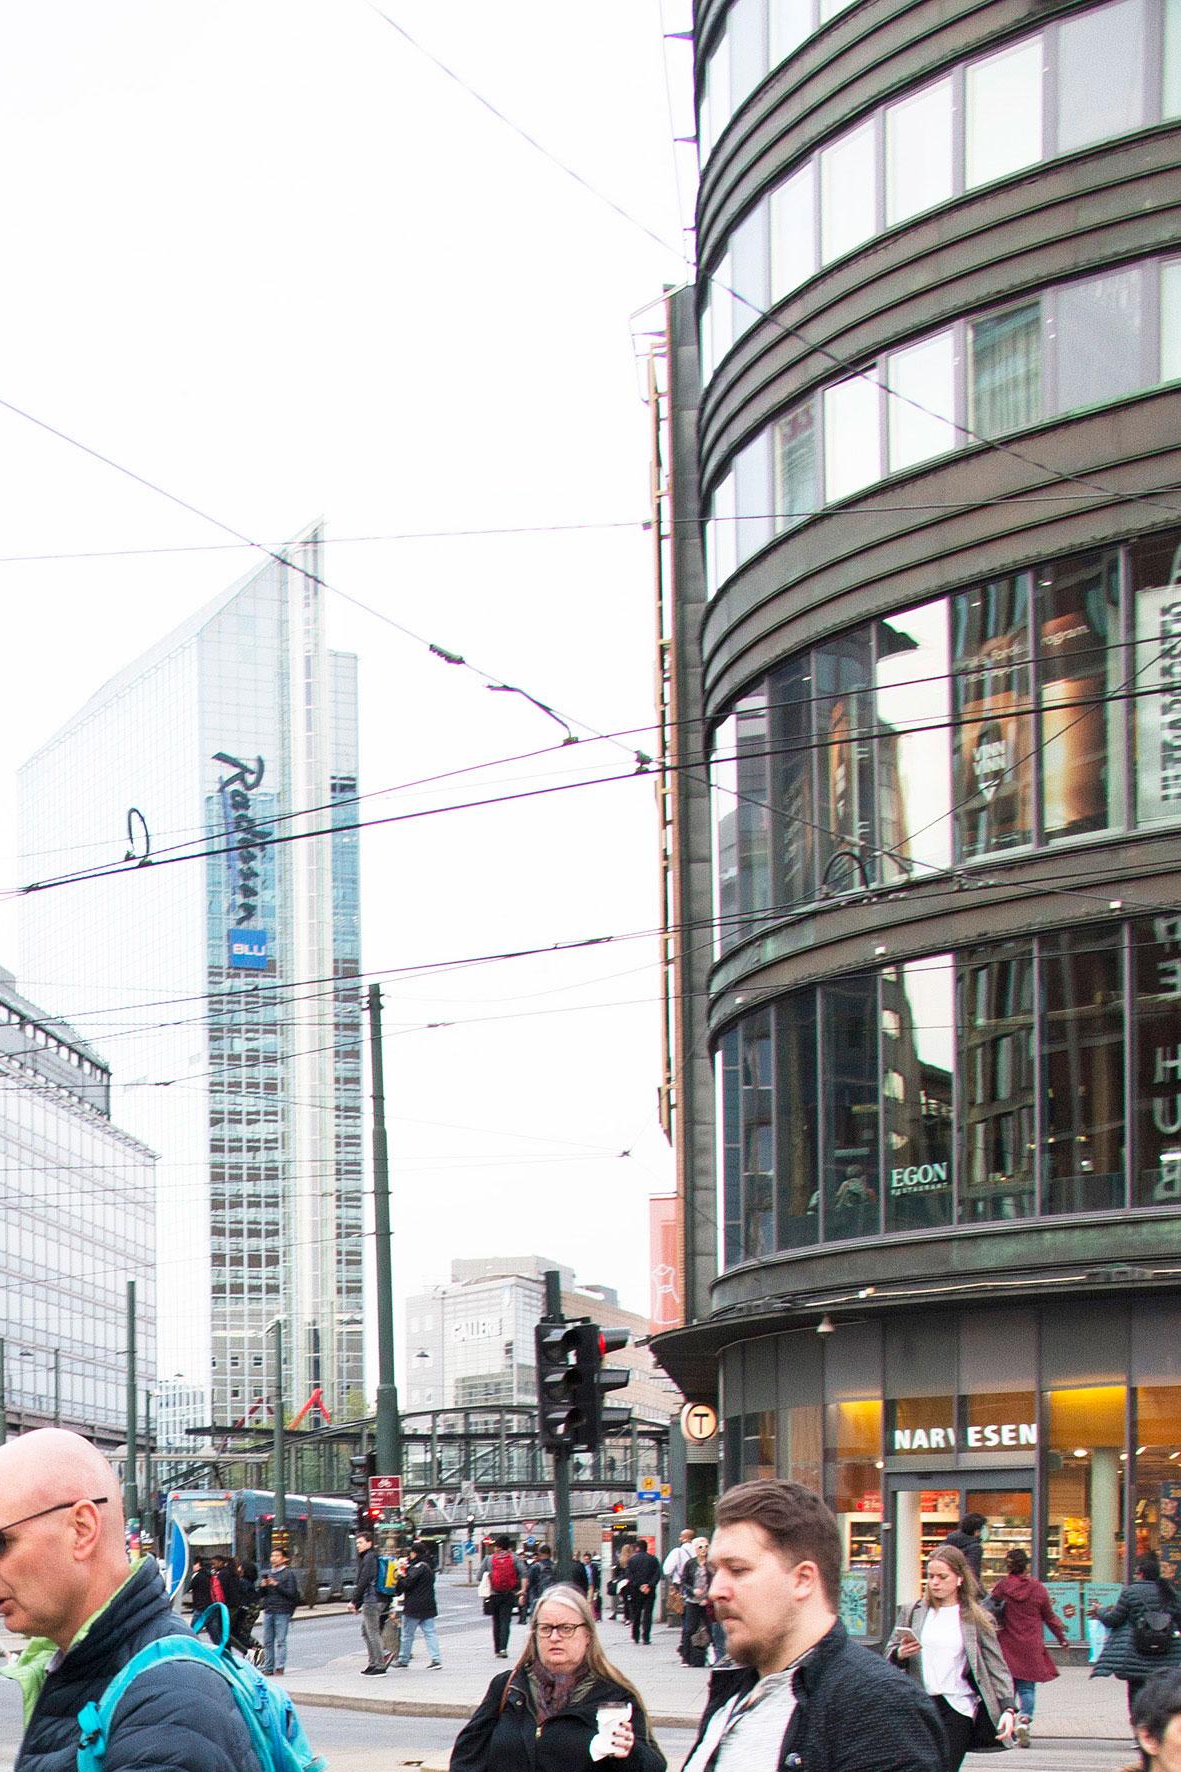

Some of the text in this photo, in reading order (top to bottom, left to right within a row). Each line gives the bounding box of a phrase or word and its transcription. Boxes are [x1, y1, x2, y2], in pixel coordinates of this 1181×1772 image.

[212, 752, 273, 926] Radisson
[233, 943, 266, 956] BLU
[890, 1161, 948, 1188] EGON
[693, 1413, 709, 1434] T
[894, 1424, 1037, 1450] NARVESEN
